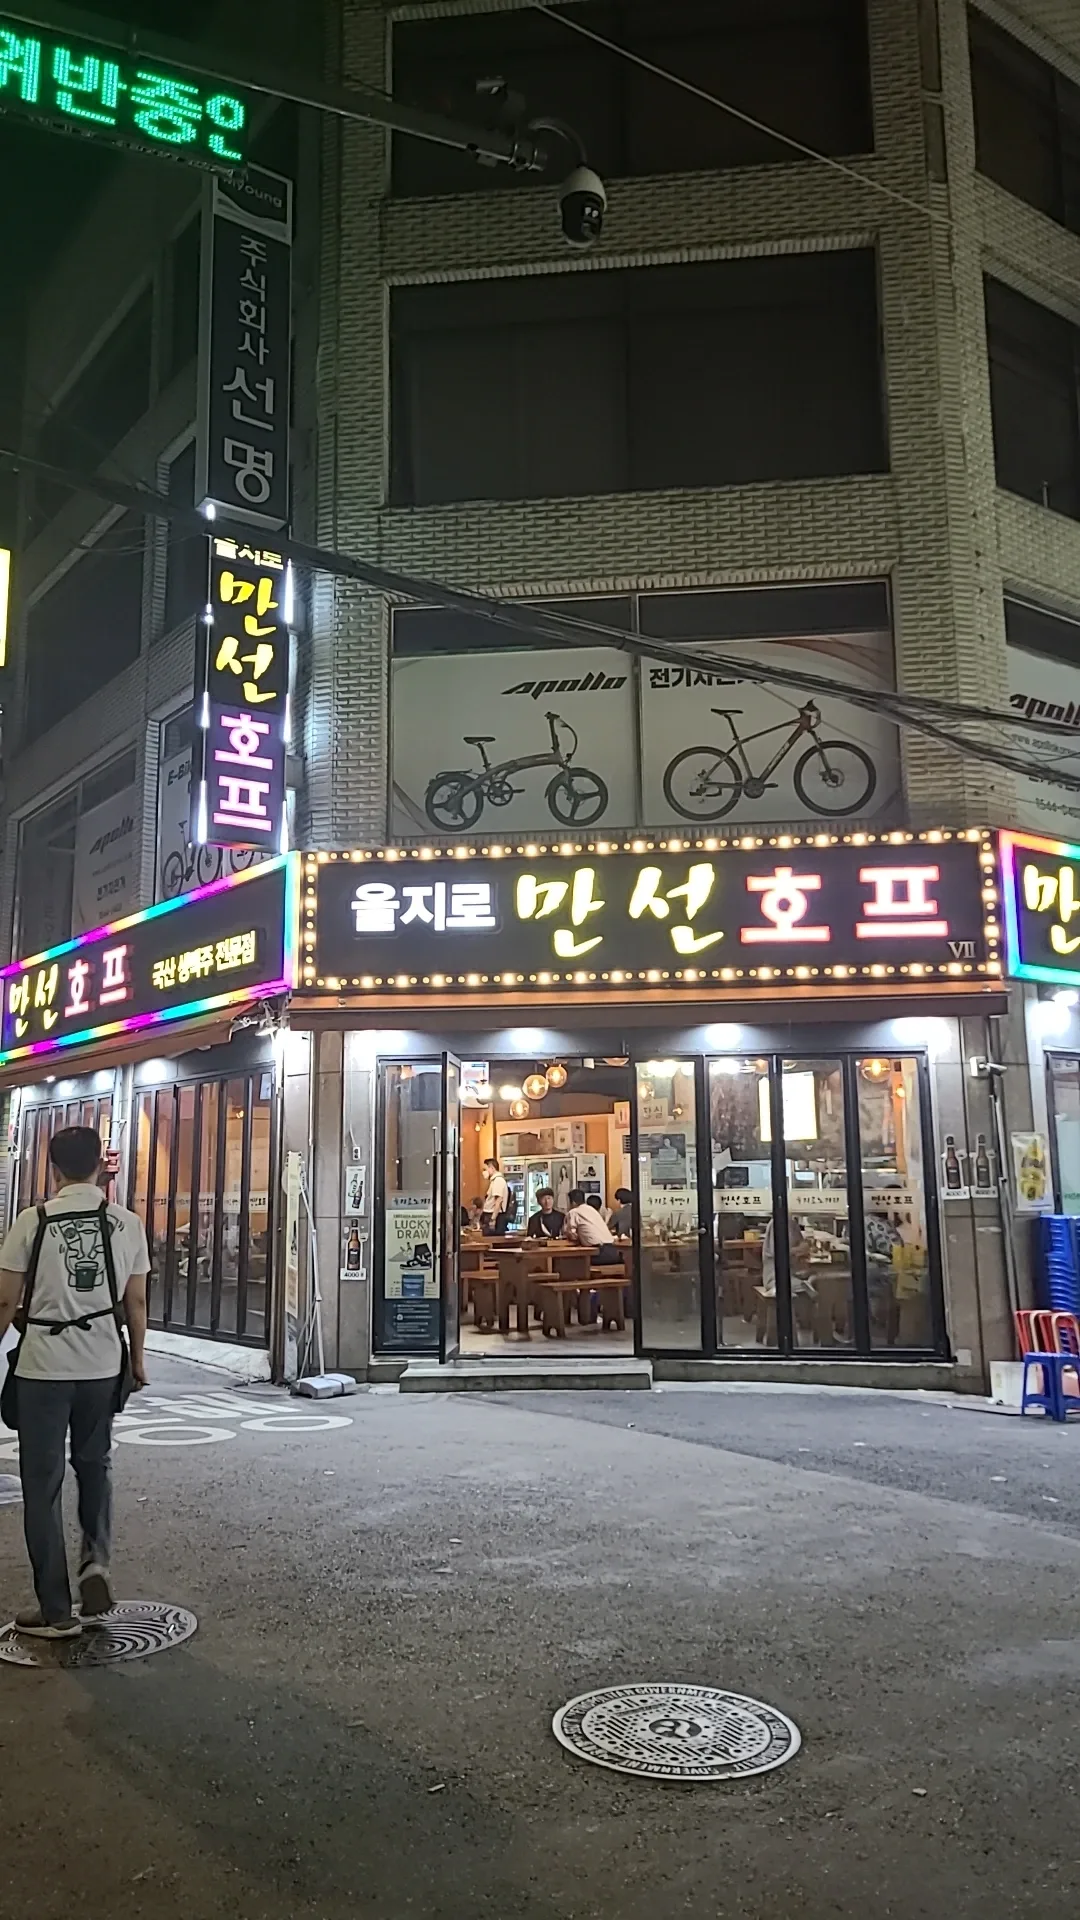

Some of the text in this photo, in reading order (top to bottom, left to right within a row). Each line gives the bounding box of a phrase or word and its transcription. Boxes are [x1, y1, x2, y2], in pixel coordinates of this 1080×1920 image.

[222, 234, 274, 504] 주식회사 선명
[500, 671, 628, 700] apollo
[649, 666, 766, 689] 전기자
[350, 882, 496, 932] 을지로
[152, 930, 256, 990] 국산 생맥주 전문점
[394, 1219, 431, 1230] LUCKY
[397, 1229, 430, 1240] DRAW
[634, 1686, 722, 1701] GOVERNMENT
